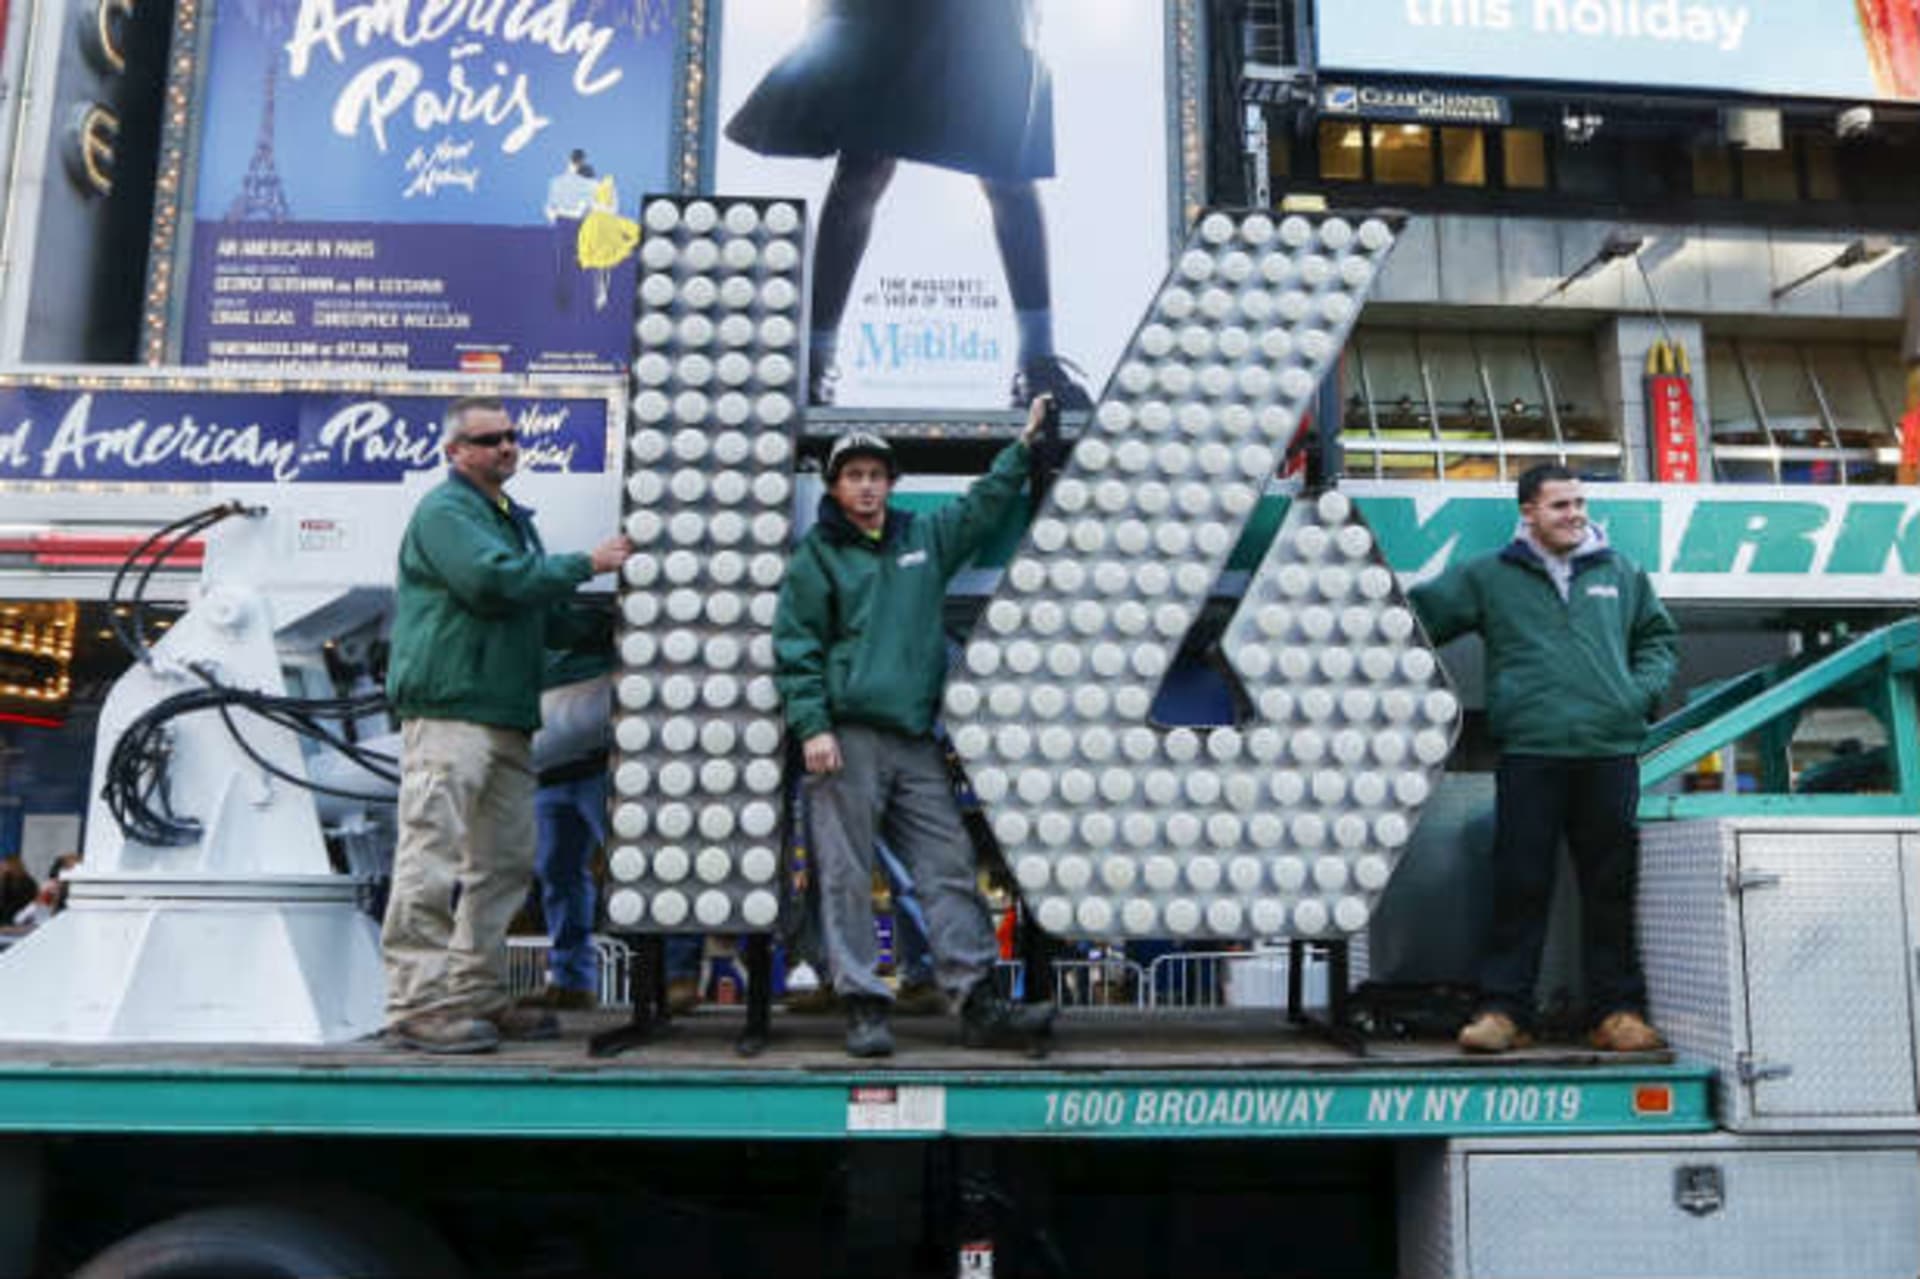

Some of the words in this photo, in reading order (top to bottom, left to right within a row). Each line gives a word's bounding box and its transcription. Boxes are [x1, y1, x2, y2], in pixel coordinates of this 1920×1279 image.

[1405, 0, 1512, 30] this
[1532, 0, 1750, 51] holiday
[332, 56, 550, 154] Paris
[853, 322, 1000, 369] Matilda
[41, 393, 300, 482] American
[517, 402, 571, 439] New
[1044, 1089, 1126, 1126] 1600
[1134, 1088, 1336, 1126] BROADWAY
[1366, 1088, 1415, 1123] NY
[1422, 1087, 1470, 1122] NY
[1481, 1086, 1582, 1121] 10019
